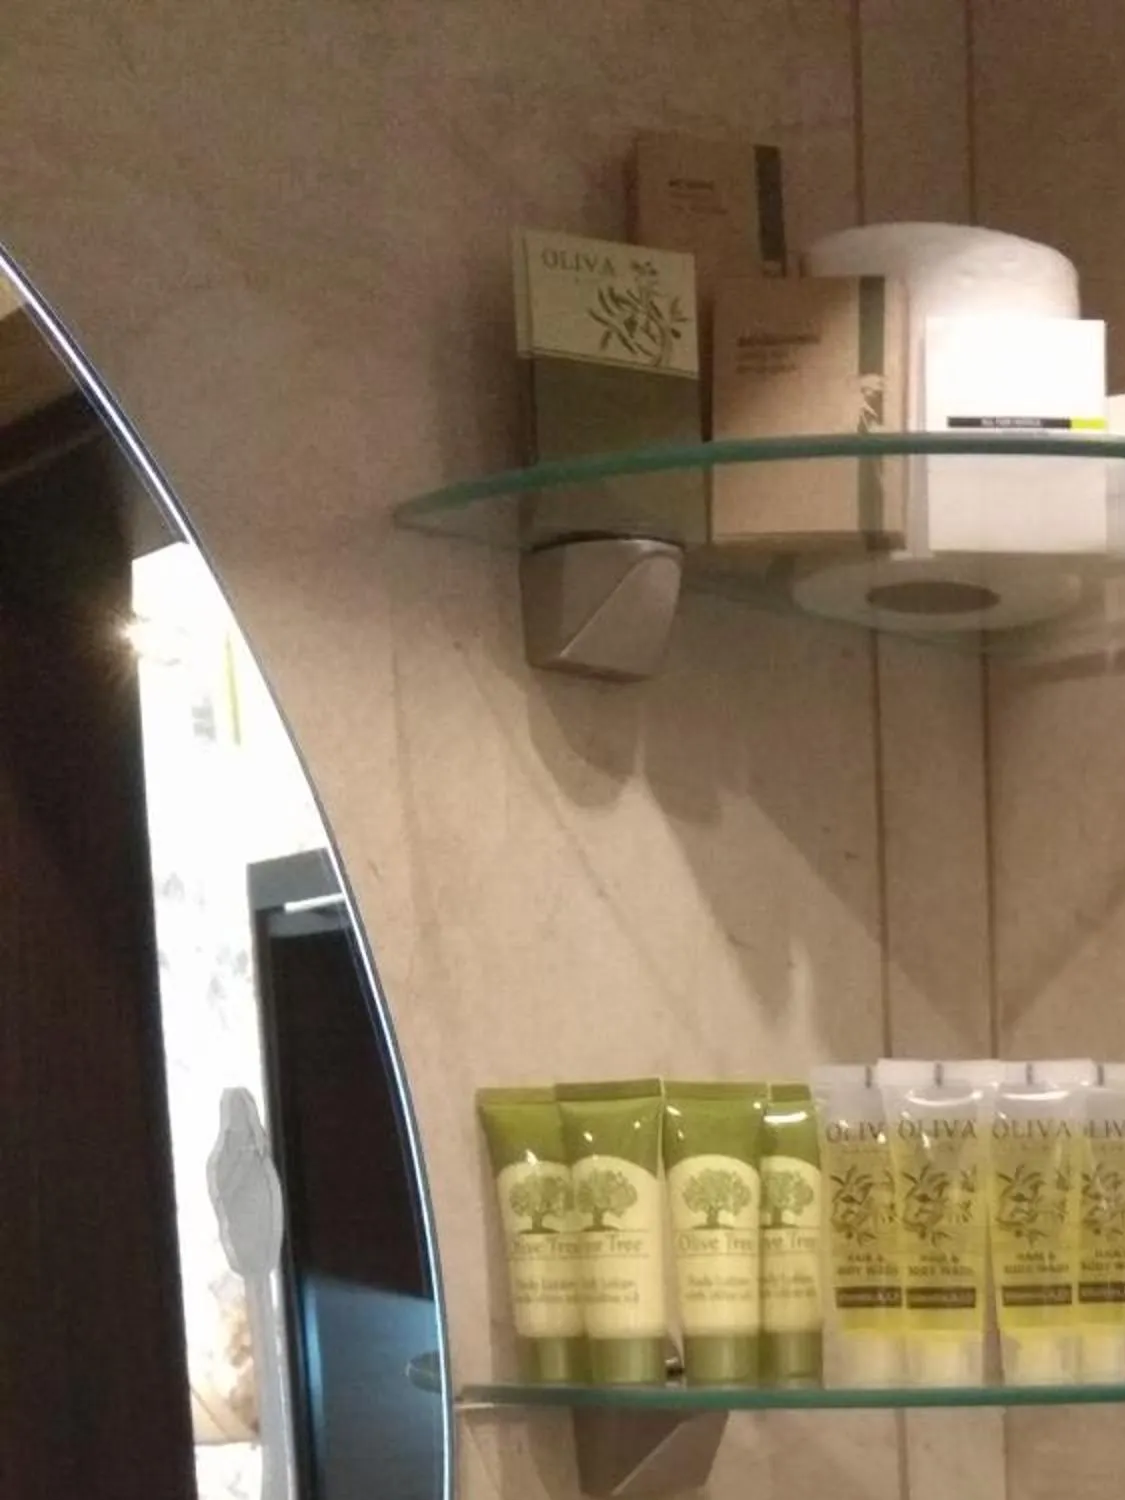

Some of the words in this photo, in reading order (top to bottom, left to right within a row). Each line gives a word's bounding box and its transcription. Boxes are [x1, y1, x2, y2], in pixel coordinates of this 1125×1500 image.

[541, 248, 615, 275] OLIVA
[898, 1118, 977, 1141] OLIVA
[992, 1118, 1071, 1140] OLIVA
